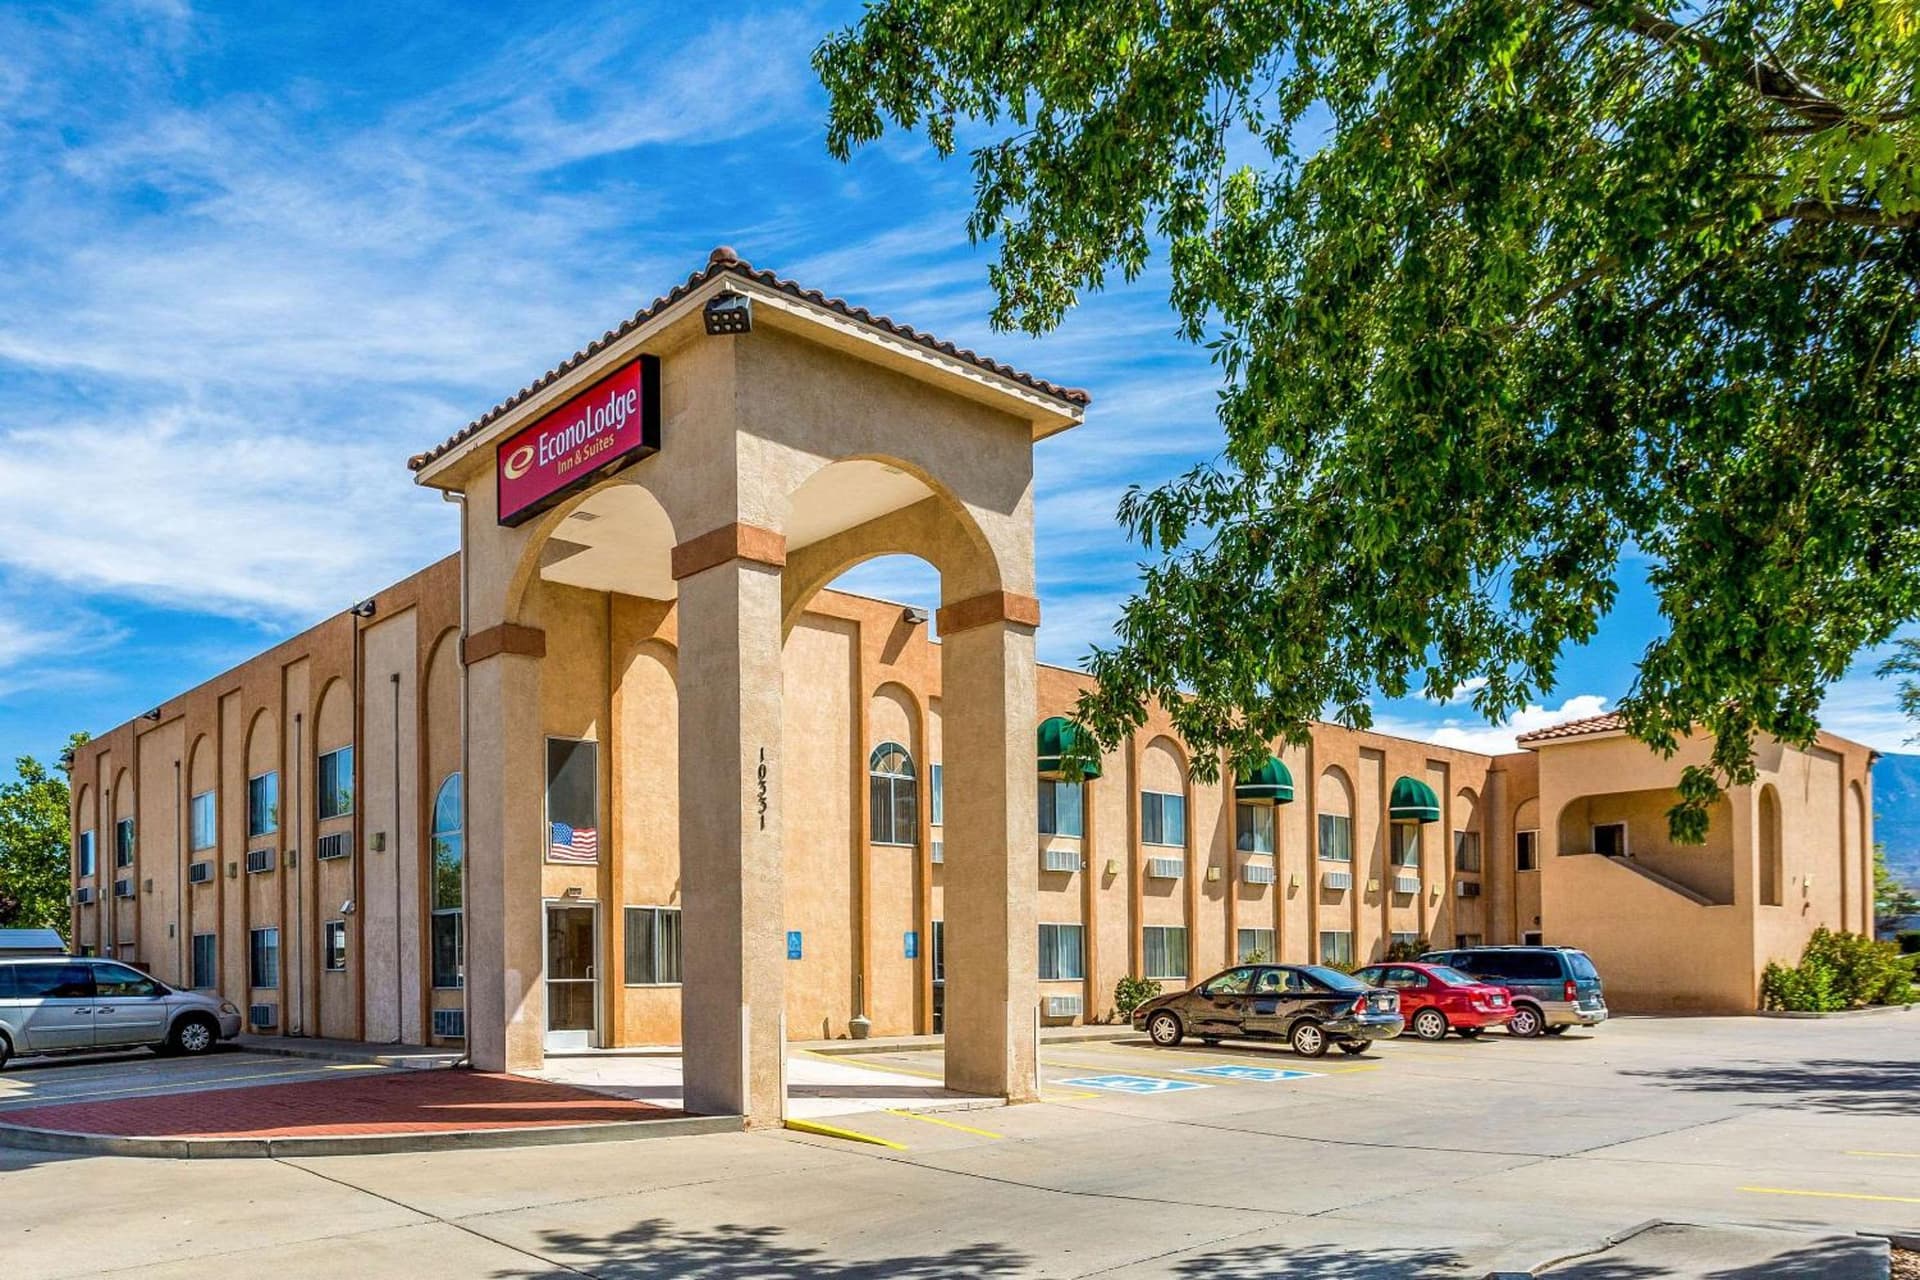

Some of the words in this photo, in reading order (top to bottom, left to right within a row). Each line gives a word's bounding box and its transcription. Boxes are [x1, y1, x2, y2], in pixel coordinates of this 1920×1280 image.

[539, 388, 637, 467] EconoLodge
[557, 456, 573, 475] Inn
[575, 449, 582, 465] &
[583, 433, 615, 461] Suites
